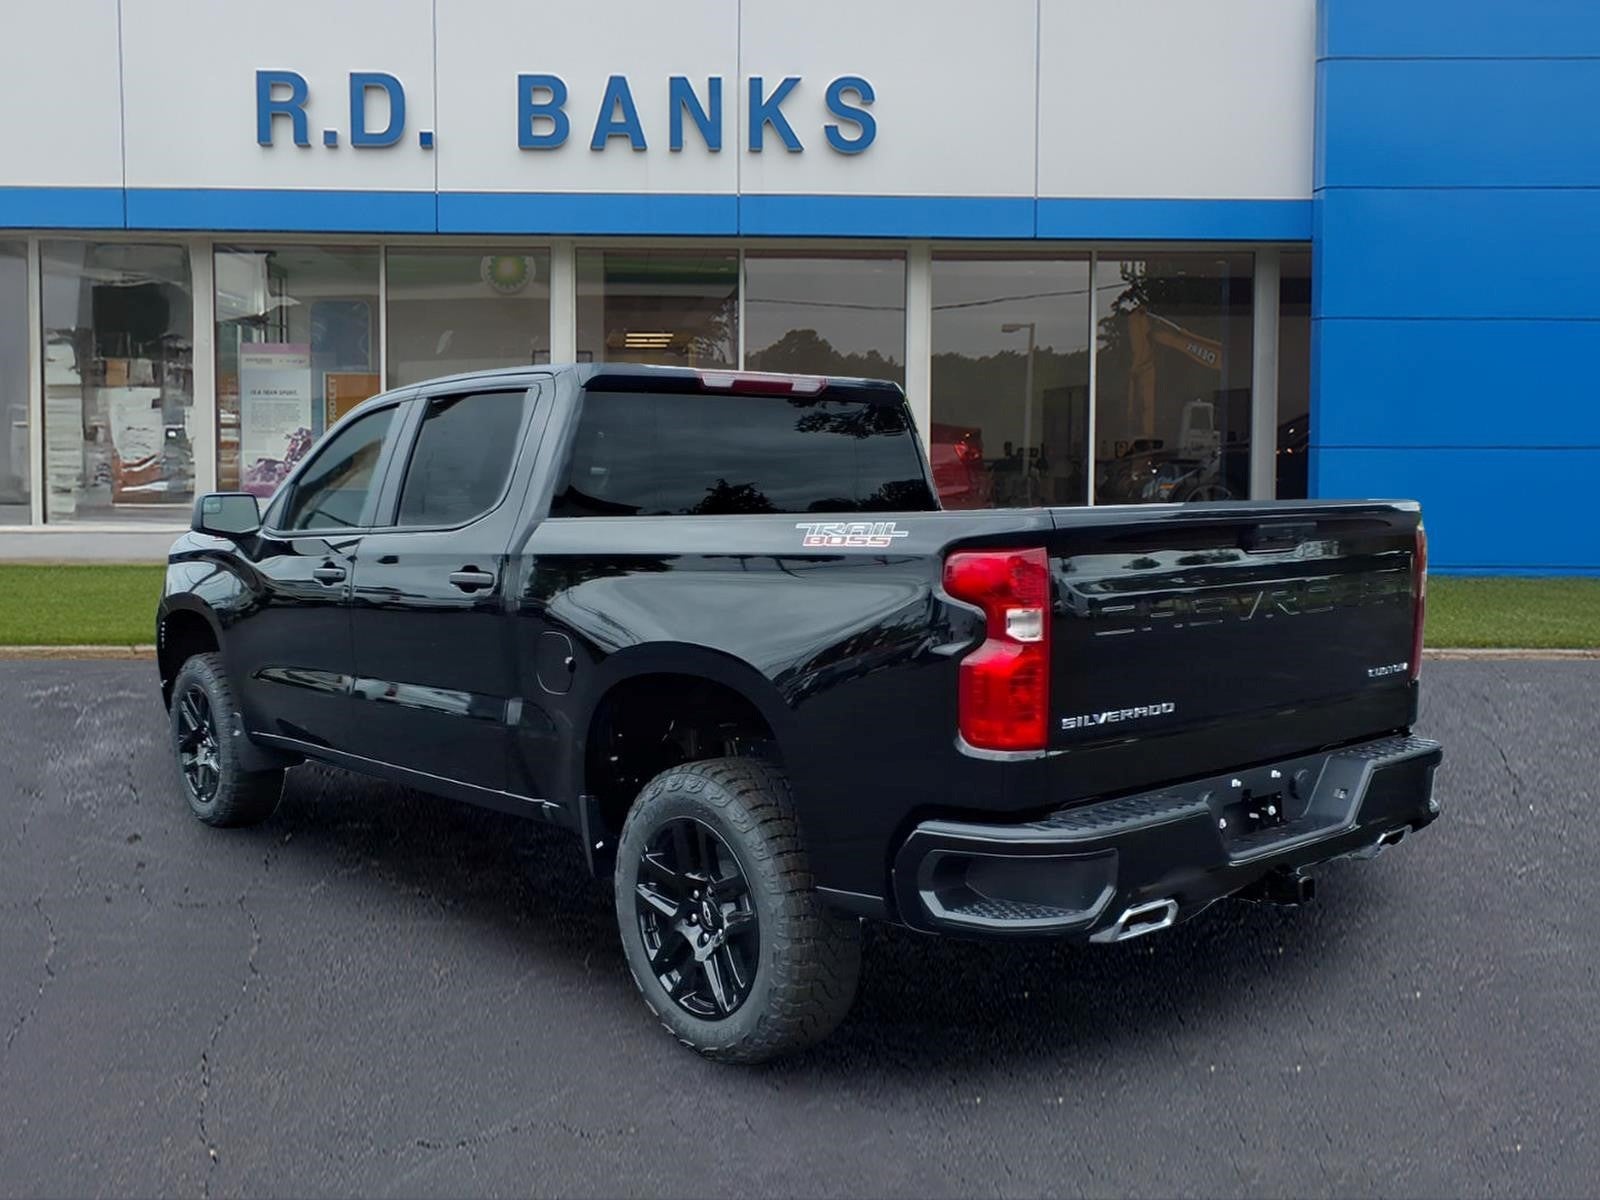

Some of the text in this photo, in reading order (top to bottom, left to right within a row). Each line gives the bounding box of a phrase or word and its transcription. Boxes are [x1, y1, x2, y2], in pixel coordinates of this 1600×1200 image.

[256, 70, 877, 155] R.D. BANKS
[796, 522, 909, 538] TRAIL
[803, 535, 892, 547] BOSS
[1061, 702, 1175, 730] SILVERADO
